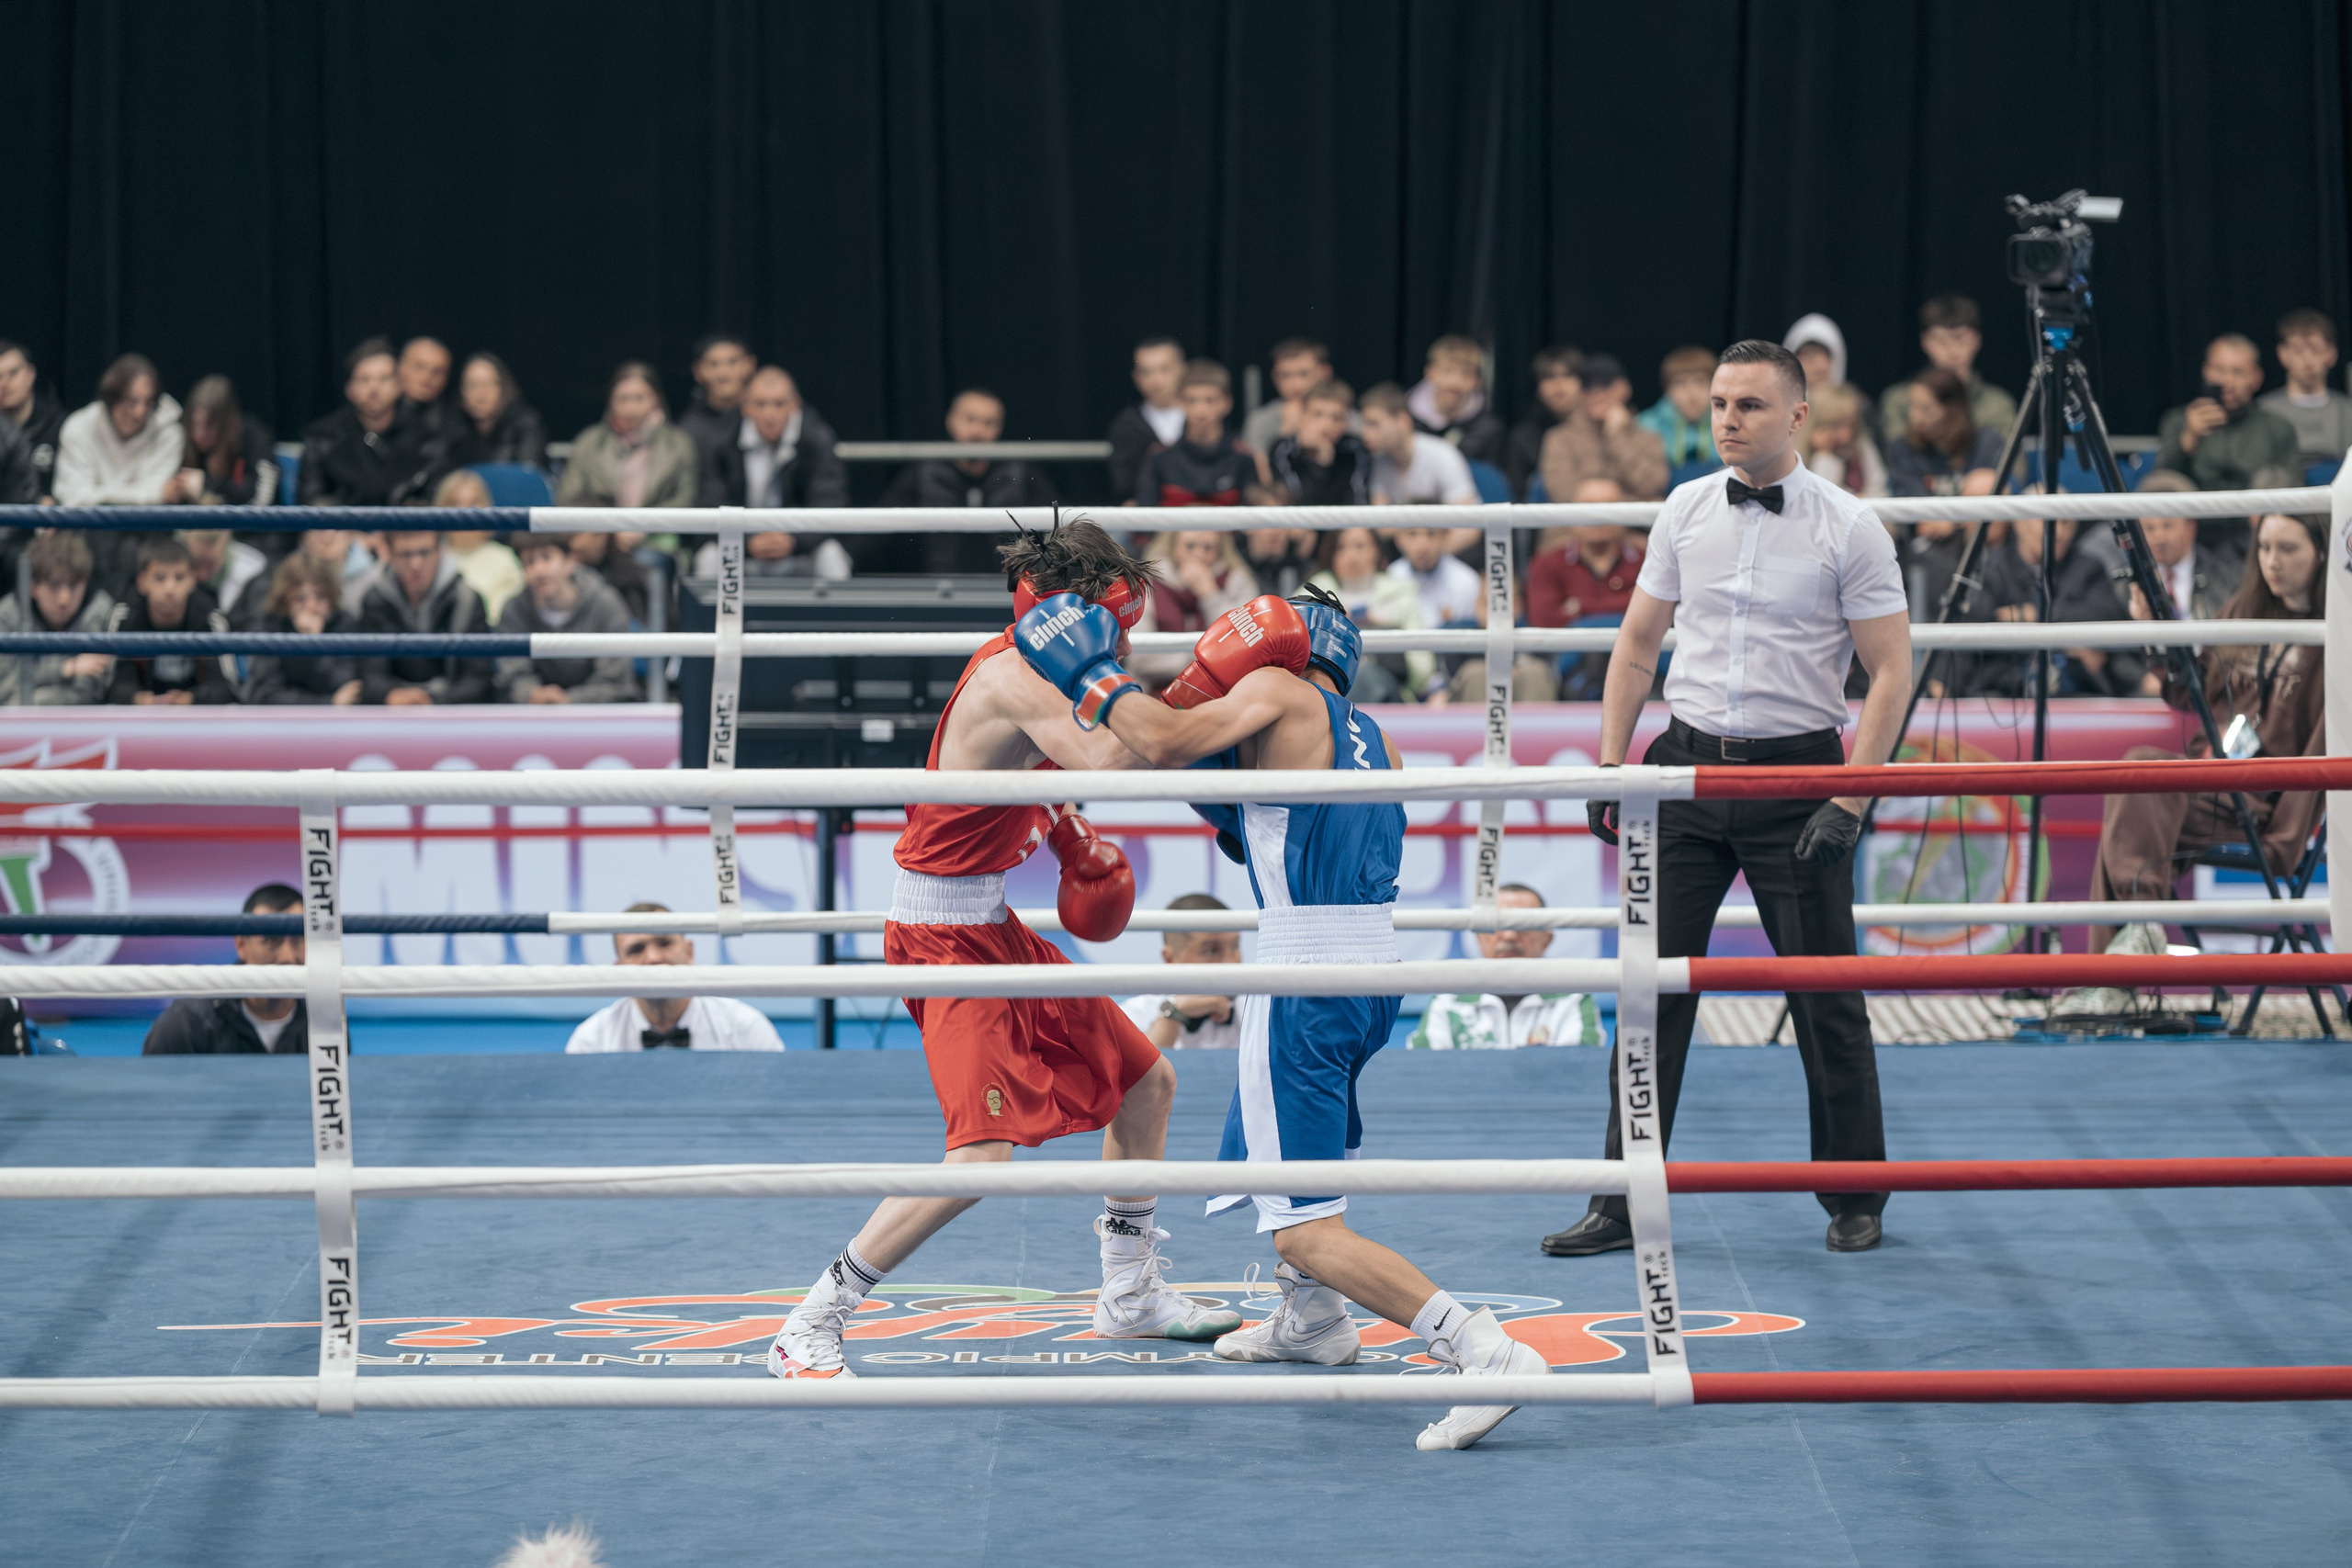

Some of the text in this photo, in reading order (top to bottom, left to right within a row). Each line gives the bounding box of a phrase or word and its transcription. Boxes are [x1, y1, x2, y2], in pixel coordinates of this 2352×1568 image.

[722, 555, 739, 615] FIGHT
[1490, 540, 1507, 601] FIGHT
[1029, 605, 1086, 651] clinch
[1119, 594, 1142, 617] clinch
[1227, 606, 1264, 648] clinch
[713, 705, 733, 763] FIGHT
[1489, 684, 1507, 747] FIGHT
[308, 829, 334, 917] FIGHT
[716, 845, 735, 904] FIGHT
[1480, 827, 1498, 887] FIGHT
[1628, 836, 1650, 925] FIGHT
[317, 1045, 344, 1135] FIGHT
[1628, 1053, 1652, 1141] FIGHT
[327, 1258, 351, 1344] FIGHT
[1645, 1269, 1678, 1355] FIGHT
